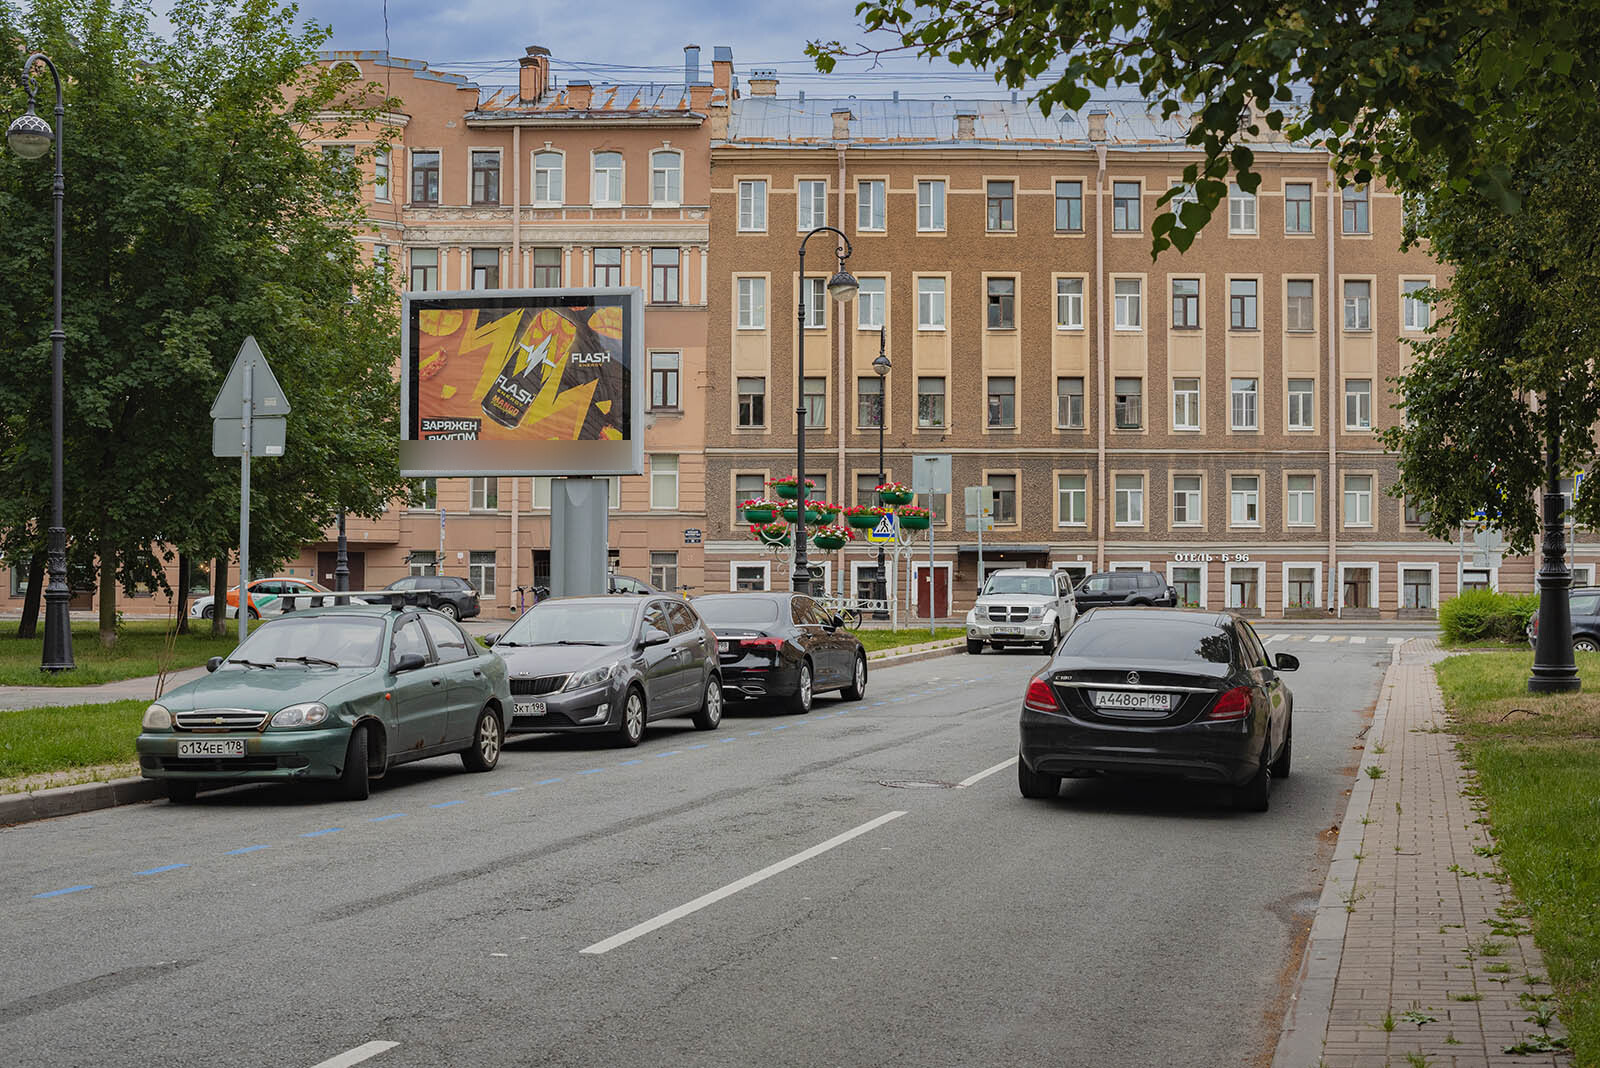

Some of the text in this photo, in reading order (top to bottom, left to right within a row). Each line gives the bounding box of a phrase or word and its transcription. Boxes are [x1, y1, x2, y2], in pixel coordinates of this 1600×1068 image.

[571, 352, 611, 364] FLASH
[494, 374, 536, 405] FLASH
[492, 395, 520, 416] MANGO
[496, 389, 524, 407] ENERGY
[422, 420, 478, 431] ЗАРЯЖЕН
[1174, 553, 1213, 562] ОТЕЛЬ
